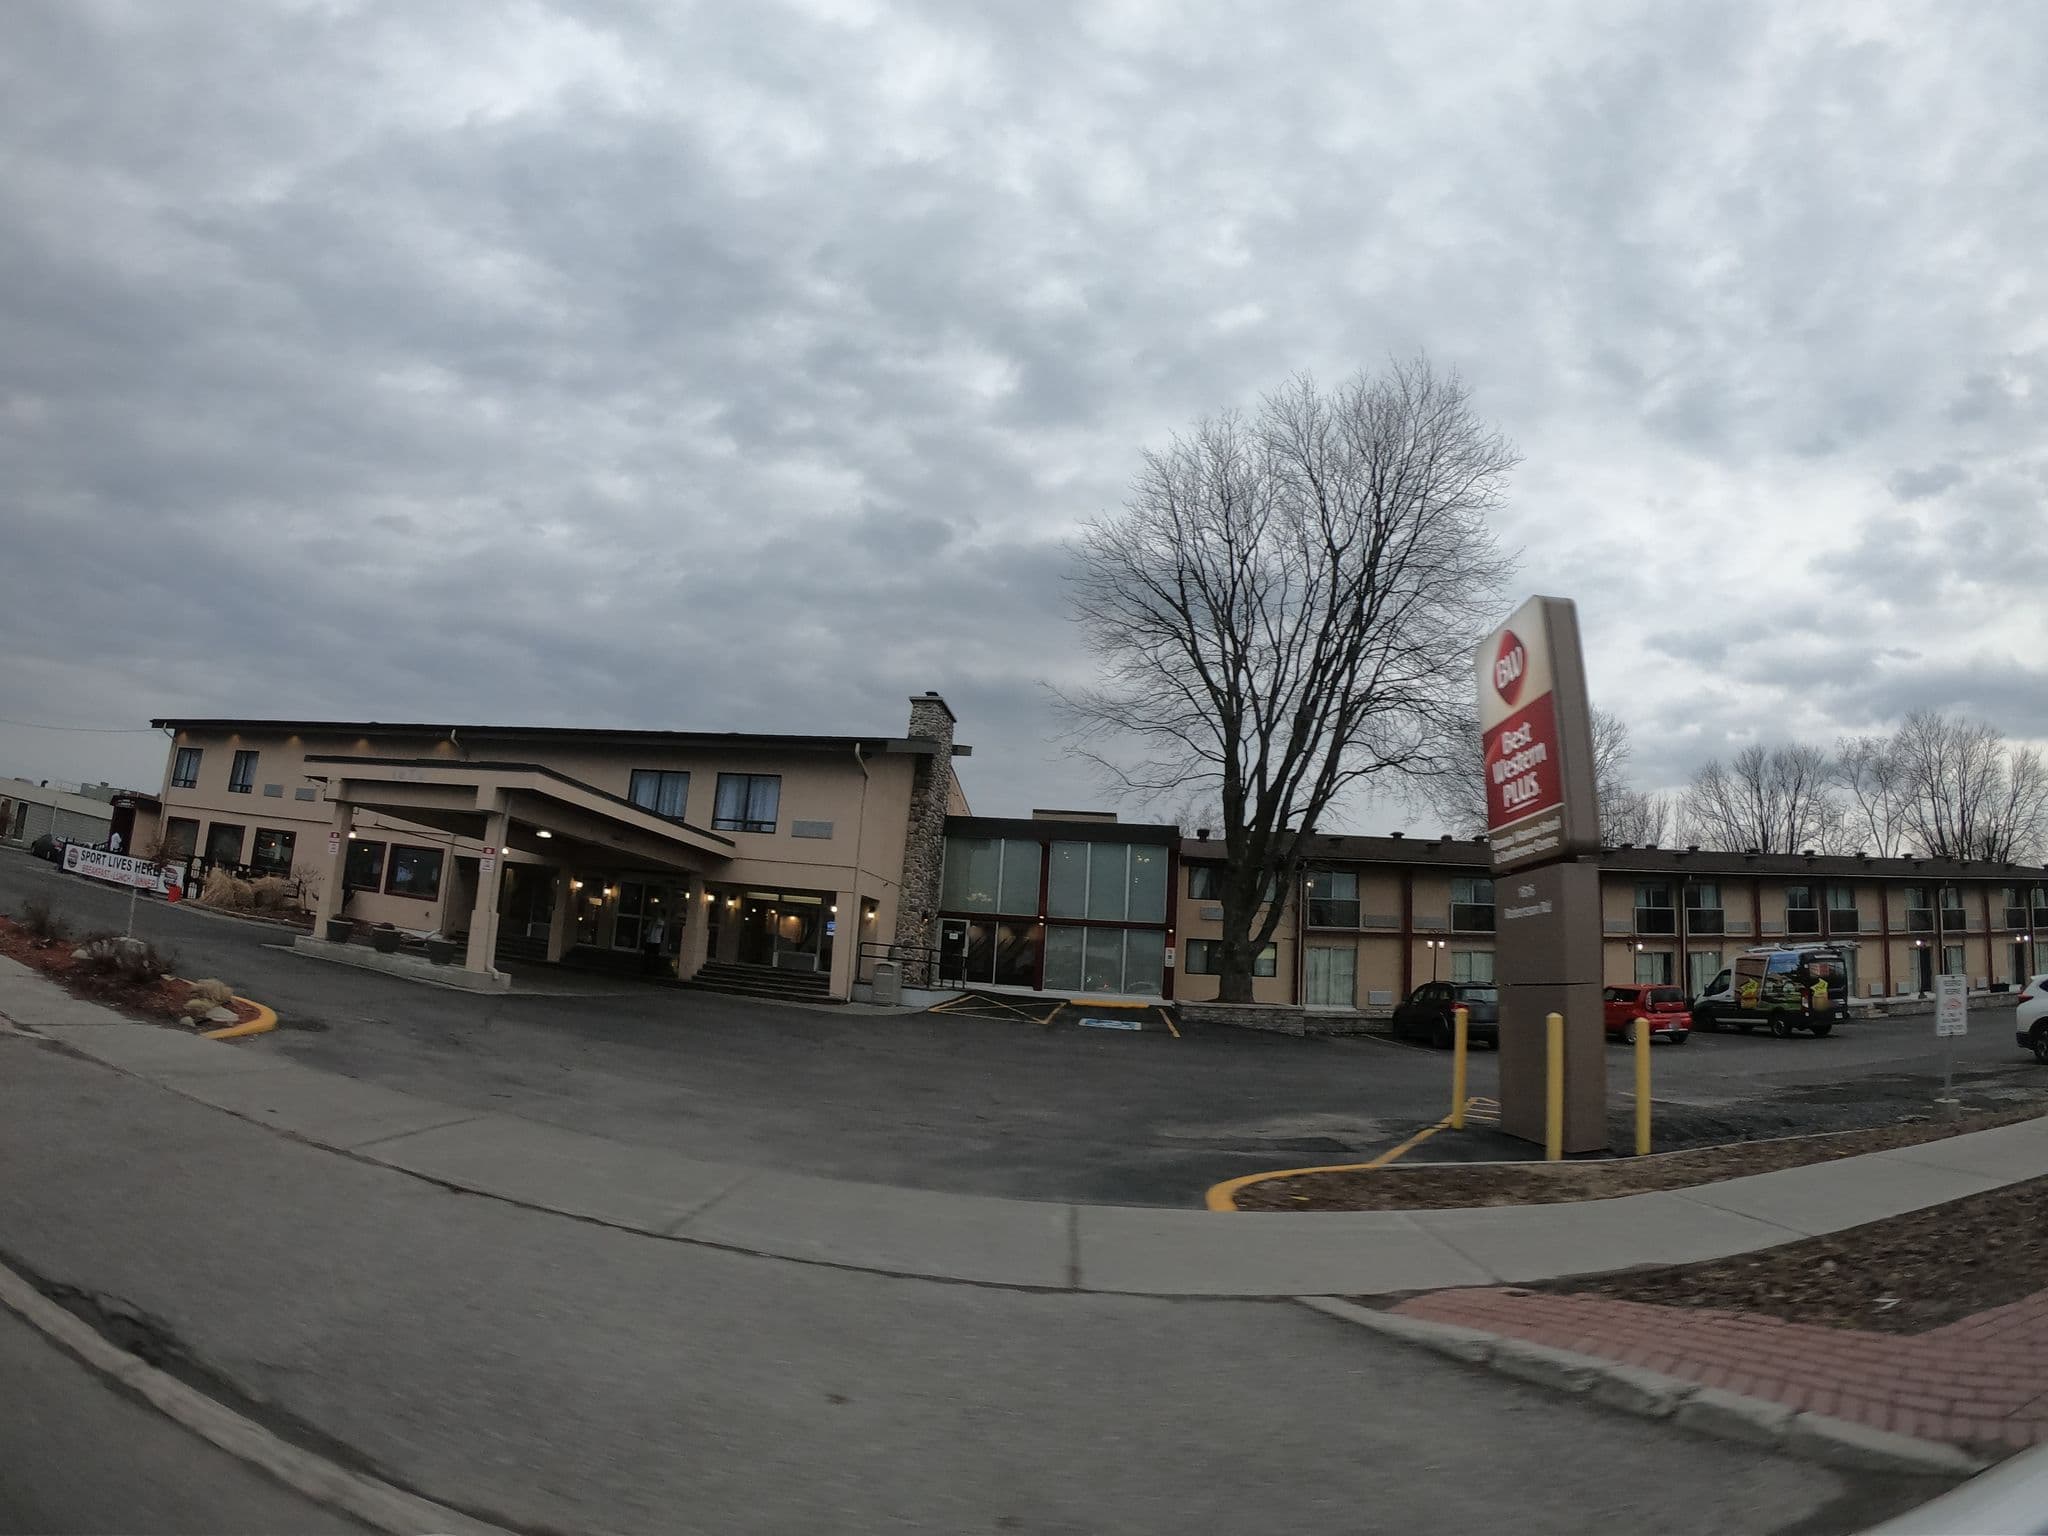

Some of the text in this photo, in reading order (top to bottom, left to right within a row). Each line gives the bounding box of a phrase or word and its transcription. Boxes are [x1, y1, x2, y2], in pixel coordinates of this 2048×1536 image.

[1501, 722, 1532, 755] Best
[1492, 742, 1547, 784] Western
[1503, 771, 1541, 807] PLUS
[80, 850, 106, 866] SPORT
[108, 855, 132, 871] LIVES
